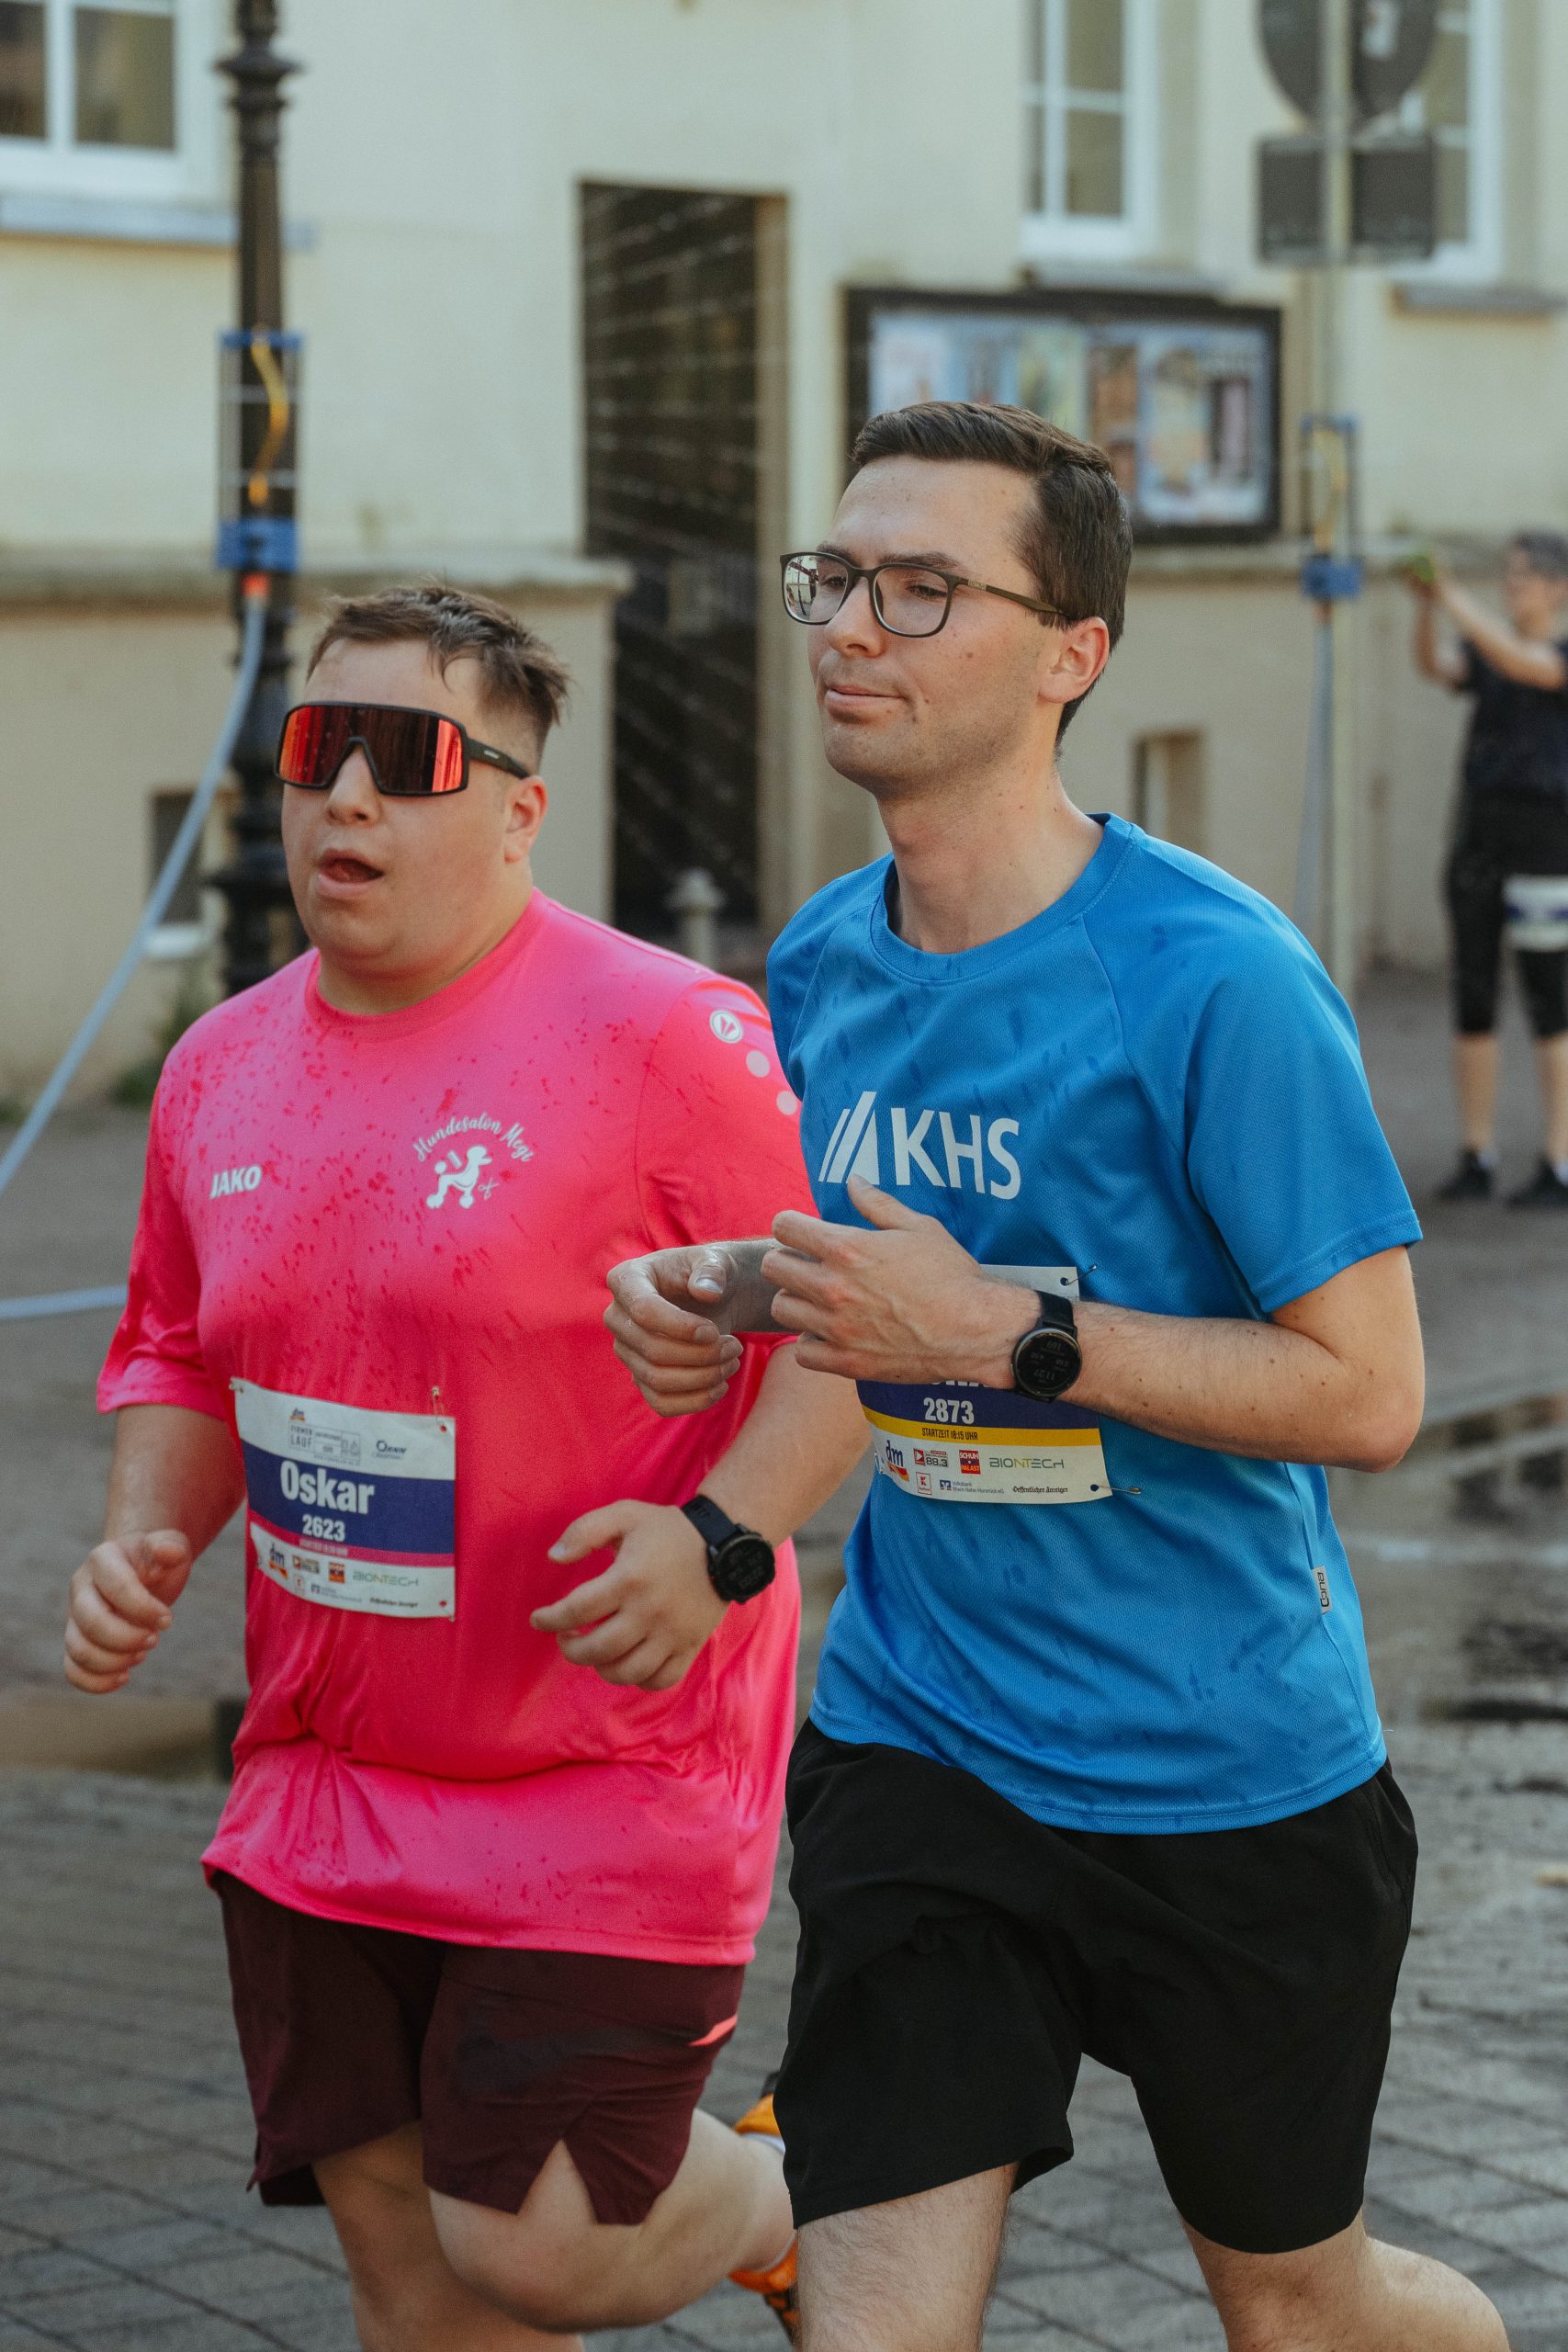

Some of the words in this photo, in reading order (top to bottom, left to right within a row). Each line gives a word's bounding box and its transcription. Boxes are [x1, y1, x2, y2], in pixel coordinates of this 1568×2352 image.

[413, 1112, 502, 1162] Hundesalon
[890, 1107, 1021, 1200] KHS
[209, 1164, 262, 1200] JAKO
[923, 1396, 975, 1425] 2873
[921, 1427, 950, 1439] STARTZEIT
[964, 1431, 978, 1441] UHR
[886, 1440, 904, 1467] dm
[925, 1456, 948, 1467] 88.3
[959, 1452, 979, 1460] SCHUH
[988, 1457, 1065, 1469] BIONTECH
[280, 1460, 375, 1514] Oskar
[301, 1514, 346, 1543] 2623
[270, 1542, 285, 1567] dm
[353, 1571, 419, 1587] BIONTECH
